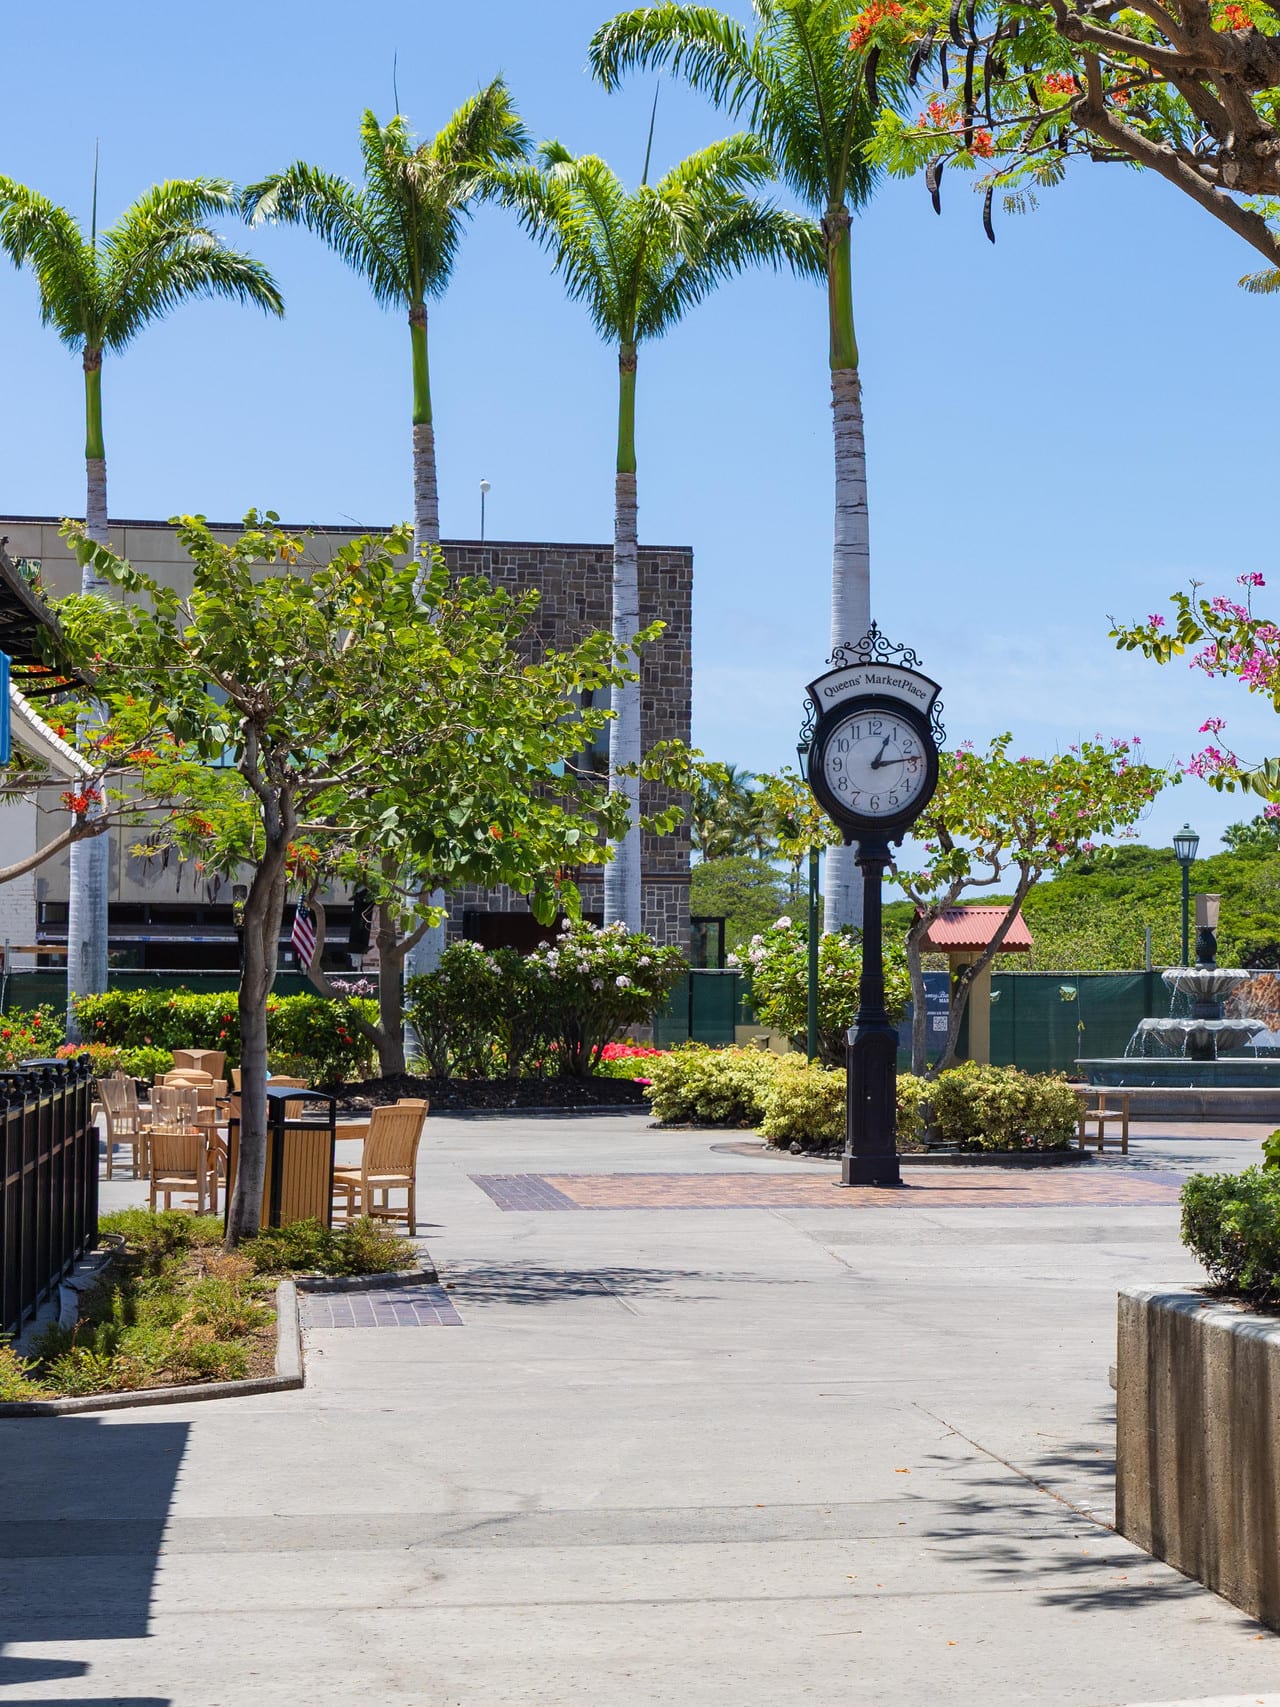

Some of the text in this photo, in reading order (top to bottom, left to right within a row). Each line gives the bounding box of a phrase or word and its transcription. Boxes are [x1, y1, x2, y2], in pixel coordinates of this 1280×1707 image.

[823, 674, 862, 698] Queens'
[850, 725, 860, 740] 11
[868, 720, 883, 736] 12
[893, 726, 897, 742] 1
[837, 738, 850, 753] 10
[902, 739, 913, 754] 2
[832, 757, 843, 773] 9
[906, 757, 918, 774] 3
[838, 776, 848, 791] 8
[900, 778, 912, 793] 4
[850, 791, 861, 806] 7
[870, 795, 880, 810] 6
[888, 790, 899, 806] 5
